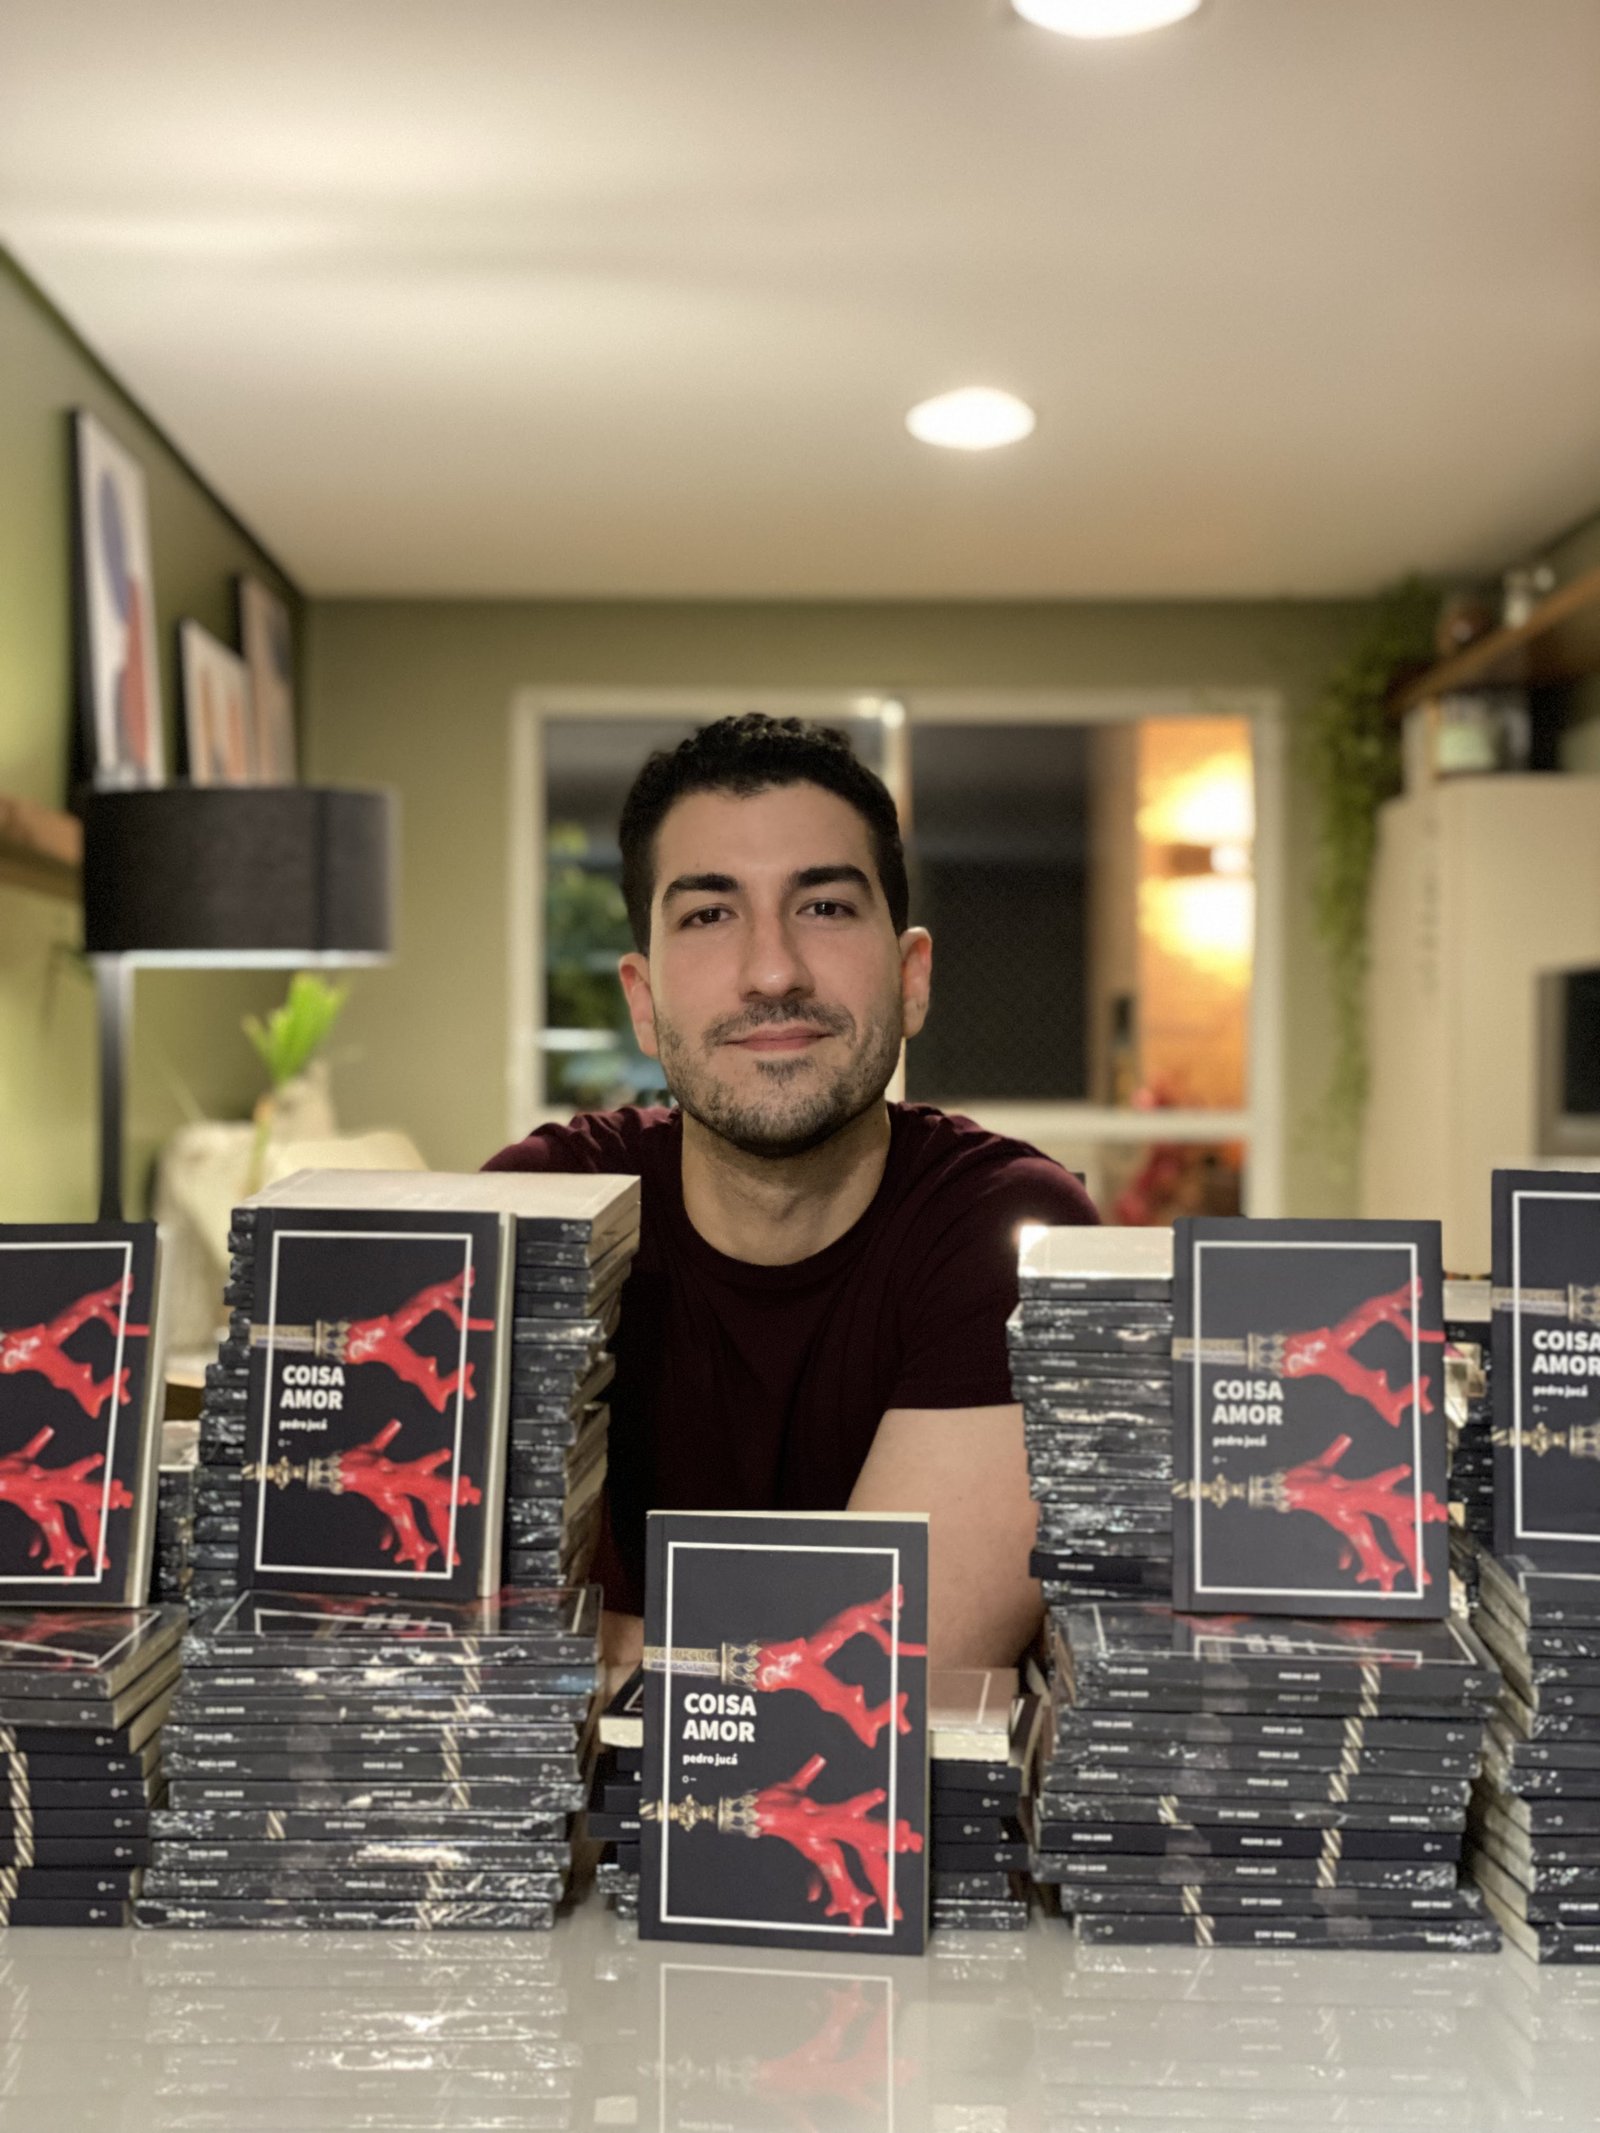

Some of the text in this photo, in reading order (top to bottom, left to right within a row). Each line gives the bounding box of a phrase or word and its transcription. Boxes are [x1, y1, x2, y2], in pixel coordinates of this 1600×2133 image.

[1532, 1329, 1600, 1352] COISA
[282, 1364, 345, 1387] COISA
[1532, 1353, 1600, 1376] AMOR
[279, 1388, 343, 1410] AMOR
[1212, 1379, 1284, 1401] COISA
[1212, 1404, 1283, 1425] AMOR
[684, 1692, 757, 1716] COISA
[682, 1719, 756, 1742] AMOR
[682, 1752, 738, 1767] pedro jucá
